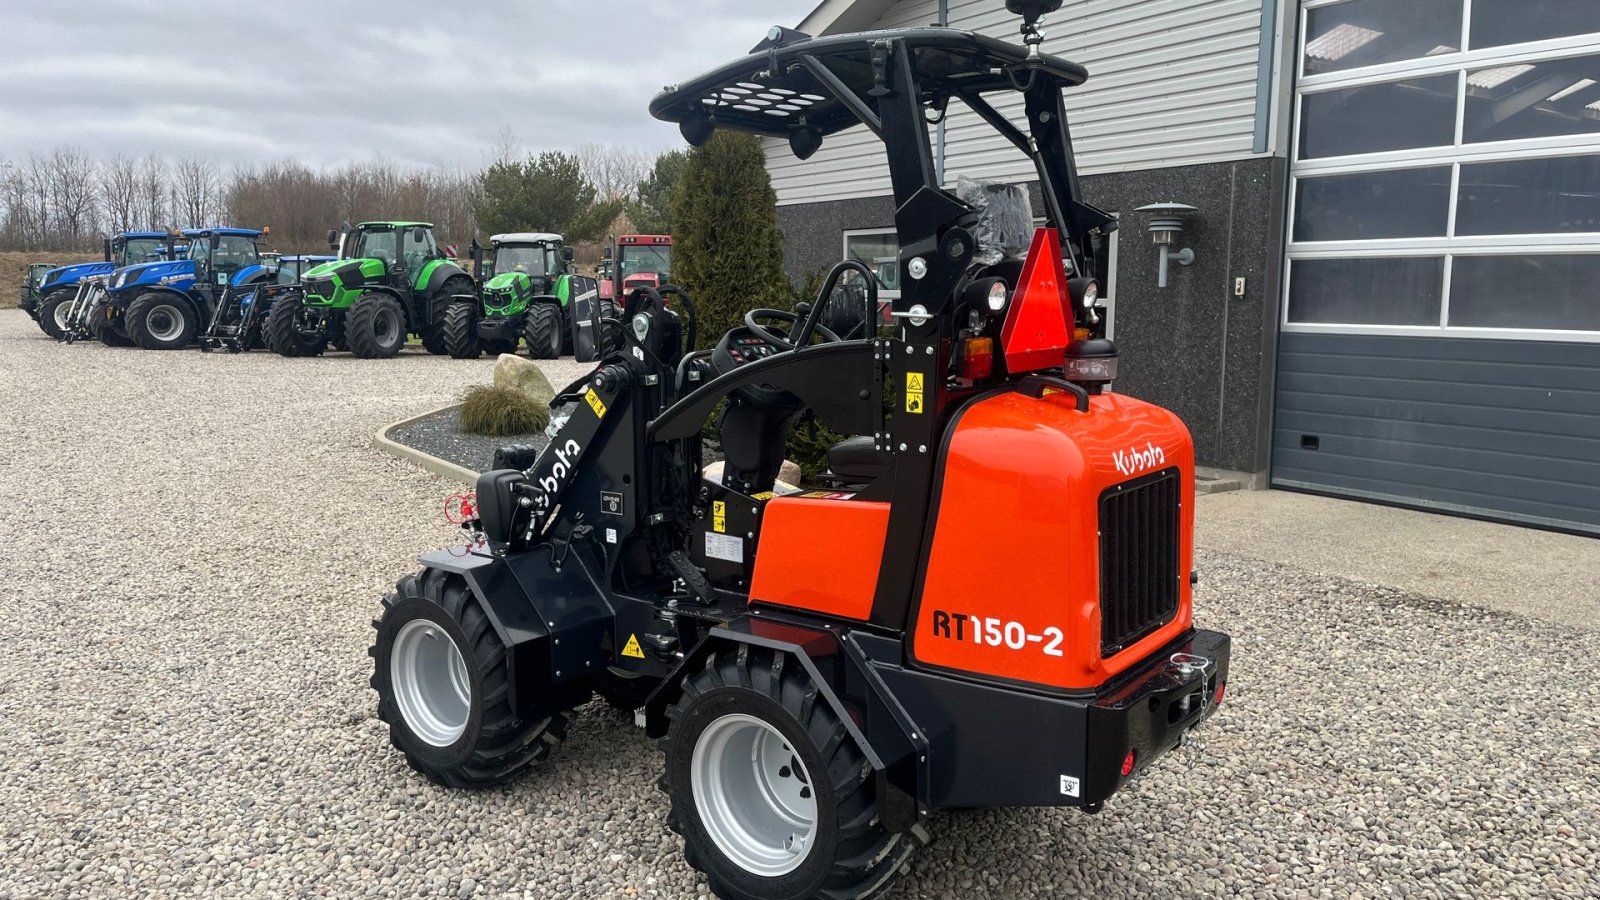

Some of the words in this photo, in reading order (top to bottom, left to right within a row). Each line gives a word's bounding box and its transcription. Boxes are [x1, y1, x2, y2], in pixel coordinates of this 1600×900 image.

[538, 439, 581, 508] bota
[1112, 441, 1165, 476] Kubota
[933, 609, 1064, 657] RT150-2
